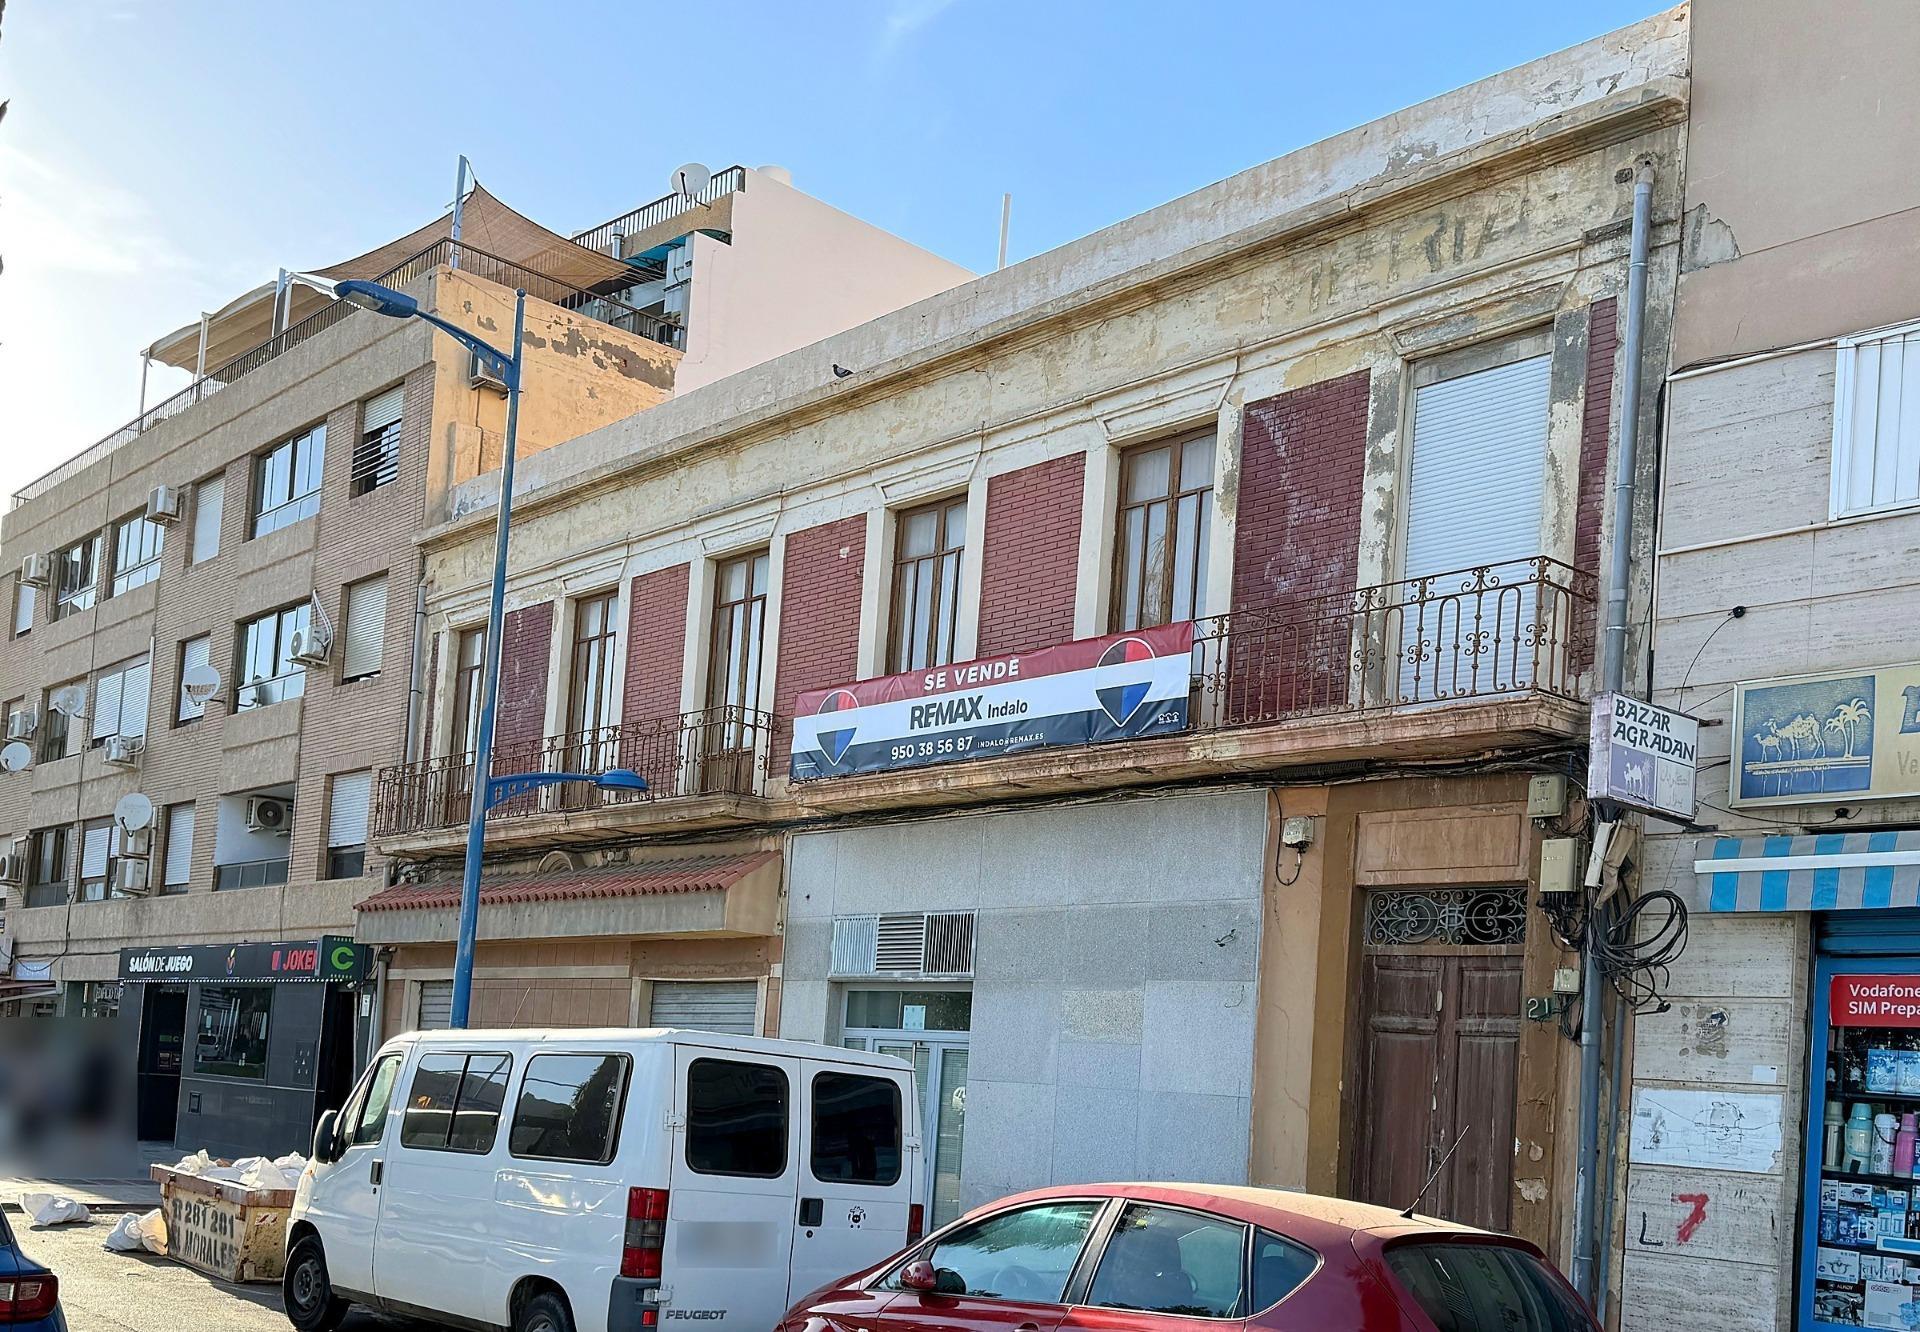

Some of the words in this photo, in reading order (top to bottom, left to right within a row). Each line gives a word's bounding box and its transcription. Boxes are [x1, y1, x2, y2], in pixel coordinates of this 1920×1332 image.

[924, 671, 946, 691] SE
[954, 659, 1020, 686] VENDE
[987, 699, 1028, 719] Indalo
[1615, 698, 1671, 733] BAZAR
[891, 745, 915, 761] 950
[918, 742, 934, 757] 38
[937, 739, 953, 754] 56
[957, 736, 973, 752] 87
[1613, 721, 1695, 762] AGRADAN
[129, 951, 155, 972] SALÓN
[155, 957, 166, 971] DE
[165, 955, 193, 972] JUEGO
[1850, 984, 1920, 998] Vodafone
[1527, 998, 1548, 1018] 21
[1849, 1001, 1877, 1015] SIM
[184, 1200, 208, 1230] 281
[210, 1210, 234, 1239] 281
[665, 1309, 727, 1320] PEUGEOT
